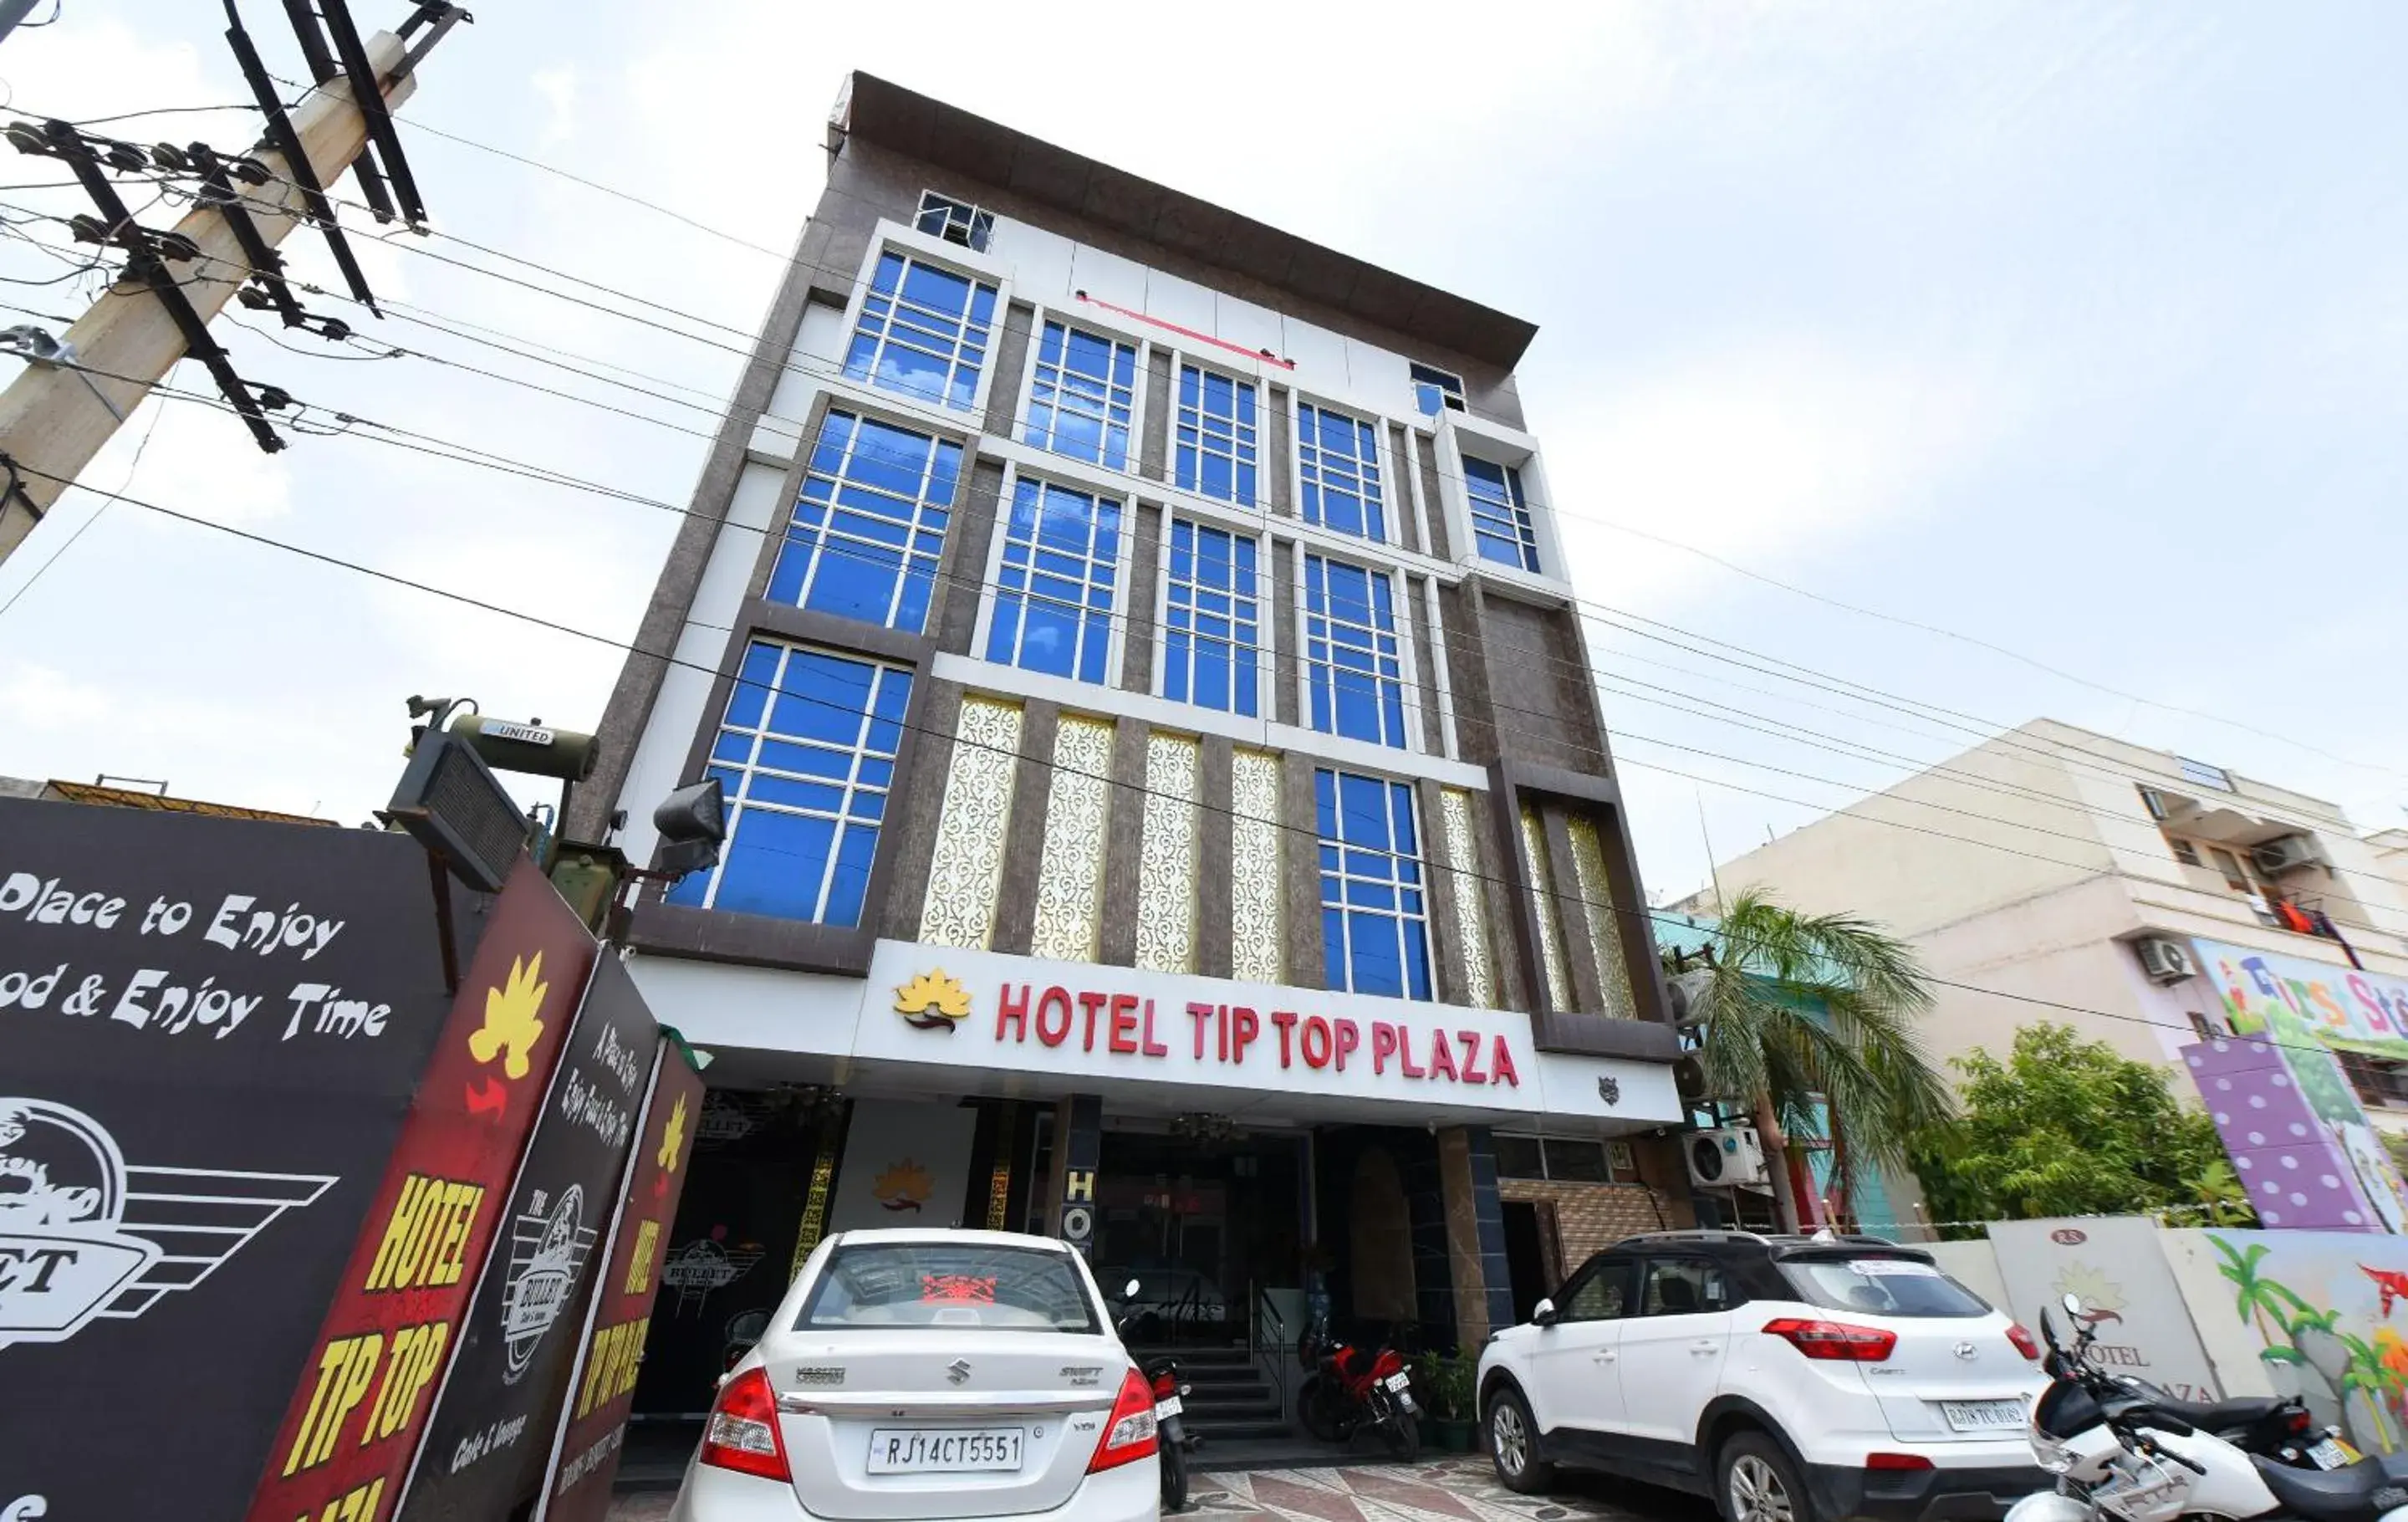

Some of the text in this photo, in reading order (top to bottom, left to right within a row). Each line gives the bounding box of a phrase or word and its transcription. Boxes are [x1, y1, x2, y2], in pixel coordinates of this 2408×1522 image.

[499, 725, 548, 743] UNITED
[0, 872, 344, 961] Place to Enjoy
[61, 973, 107, 1017] &
[110, 968, 263, 1039] Enjoy
[281, 983, 391, 1041] Time
[995, 983, 1519, 1087] HOTEL TIP TOP PLAZA
[365, 1175, 485, 1290] HOTEL
[1064, 1172, 1094, 1253] HO
[282, 1322, 449, 1478] TIP TOP
[2161, 1382, 2216, 1404] AZA
[887, 1436, 1019, 1463] RJ14CT5551
